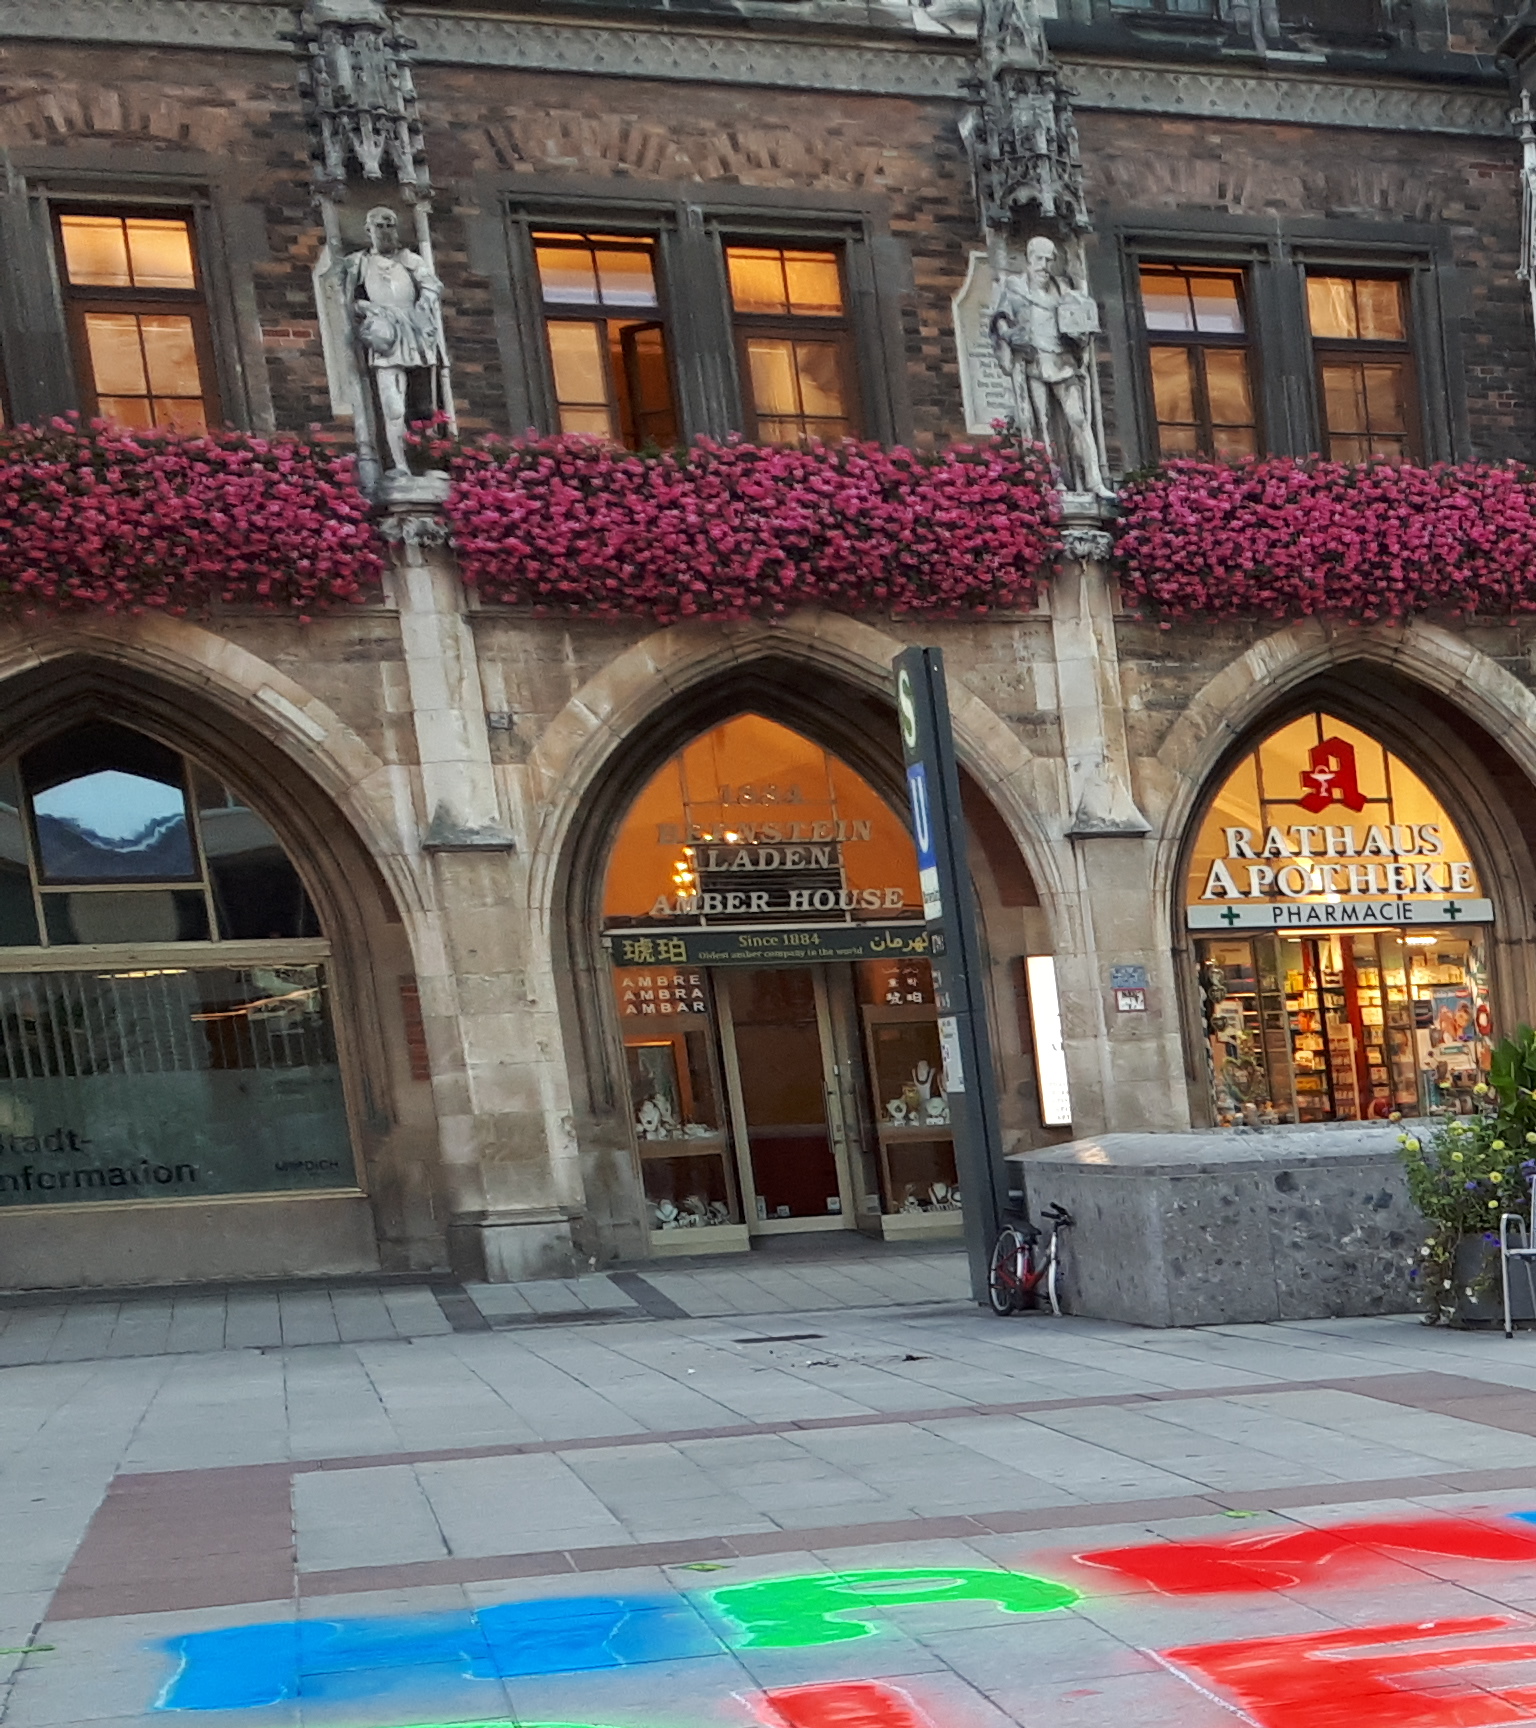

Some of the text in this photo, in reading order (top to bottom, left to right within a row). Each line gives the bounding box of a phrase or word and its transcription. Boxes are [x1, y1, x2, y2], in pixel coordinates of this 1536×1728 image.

[899, 669, 916, 748] S
[910, 775, 929, 854] U
[1223, 824, 1445, 860] RATHAUS
[706, 846, 832, 872] LADEN
[1200, 859, 1477, 900] APOTHEKE
[648, 891, 771, 917] AMBER
[789, 887, 905, 912] HOUSE
[1272, 902, 1414, 924] PHARMACIE
[621, 936, 688, 963] 琥珀
[738, 932, 822, 948] Since 1884
[764, 948, 805, 959] company
[818, 947, 834, 956] the
[622, 974, 701, 988] AMBRE
[623, 988, 704, 1001] AMBRA
[625, 1001, 706, 1015] AMBAR
[0, 1160, 199, 1193] nformation
